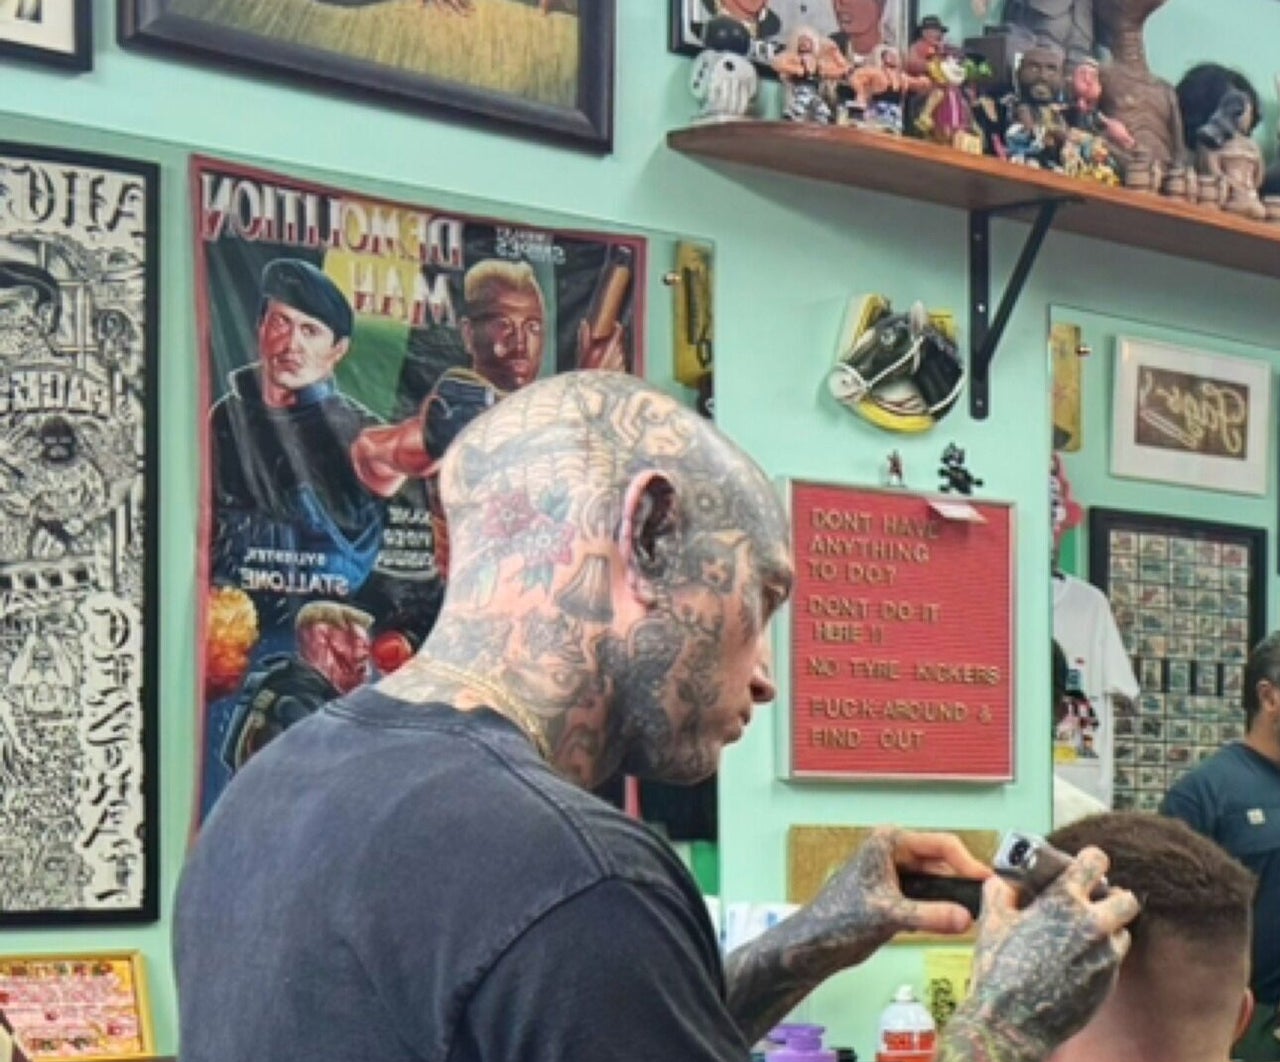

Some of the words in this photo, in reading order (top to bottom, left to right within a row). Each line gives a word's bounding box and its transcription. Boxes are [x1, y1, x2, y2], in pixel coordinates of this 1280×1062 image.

[811, 507, 872, 532] DONT
[883, 512, 940, 539] HAVE
[810, 534, 930, 563] ANYTHING
[807, 560, 838, 581] TO
[807, 594, 870, 618] DONT
[880, 600, 914, 621] DO
[921, 603, 940, 624] IT
[812, 620, 862, 643] HERE
[806, 656, 837, 677] NO
[914, 662, 1001, 686] KICKERS
[809, 697, 873, 720] FUCK
[882, 700, 968, 724] AROUND
[810, 728, 862, 751] FIND
[879, 729, 924, 752] OUT
